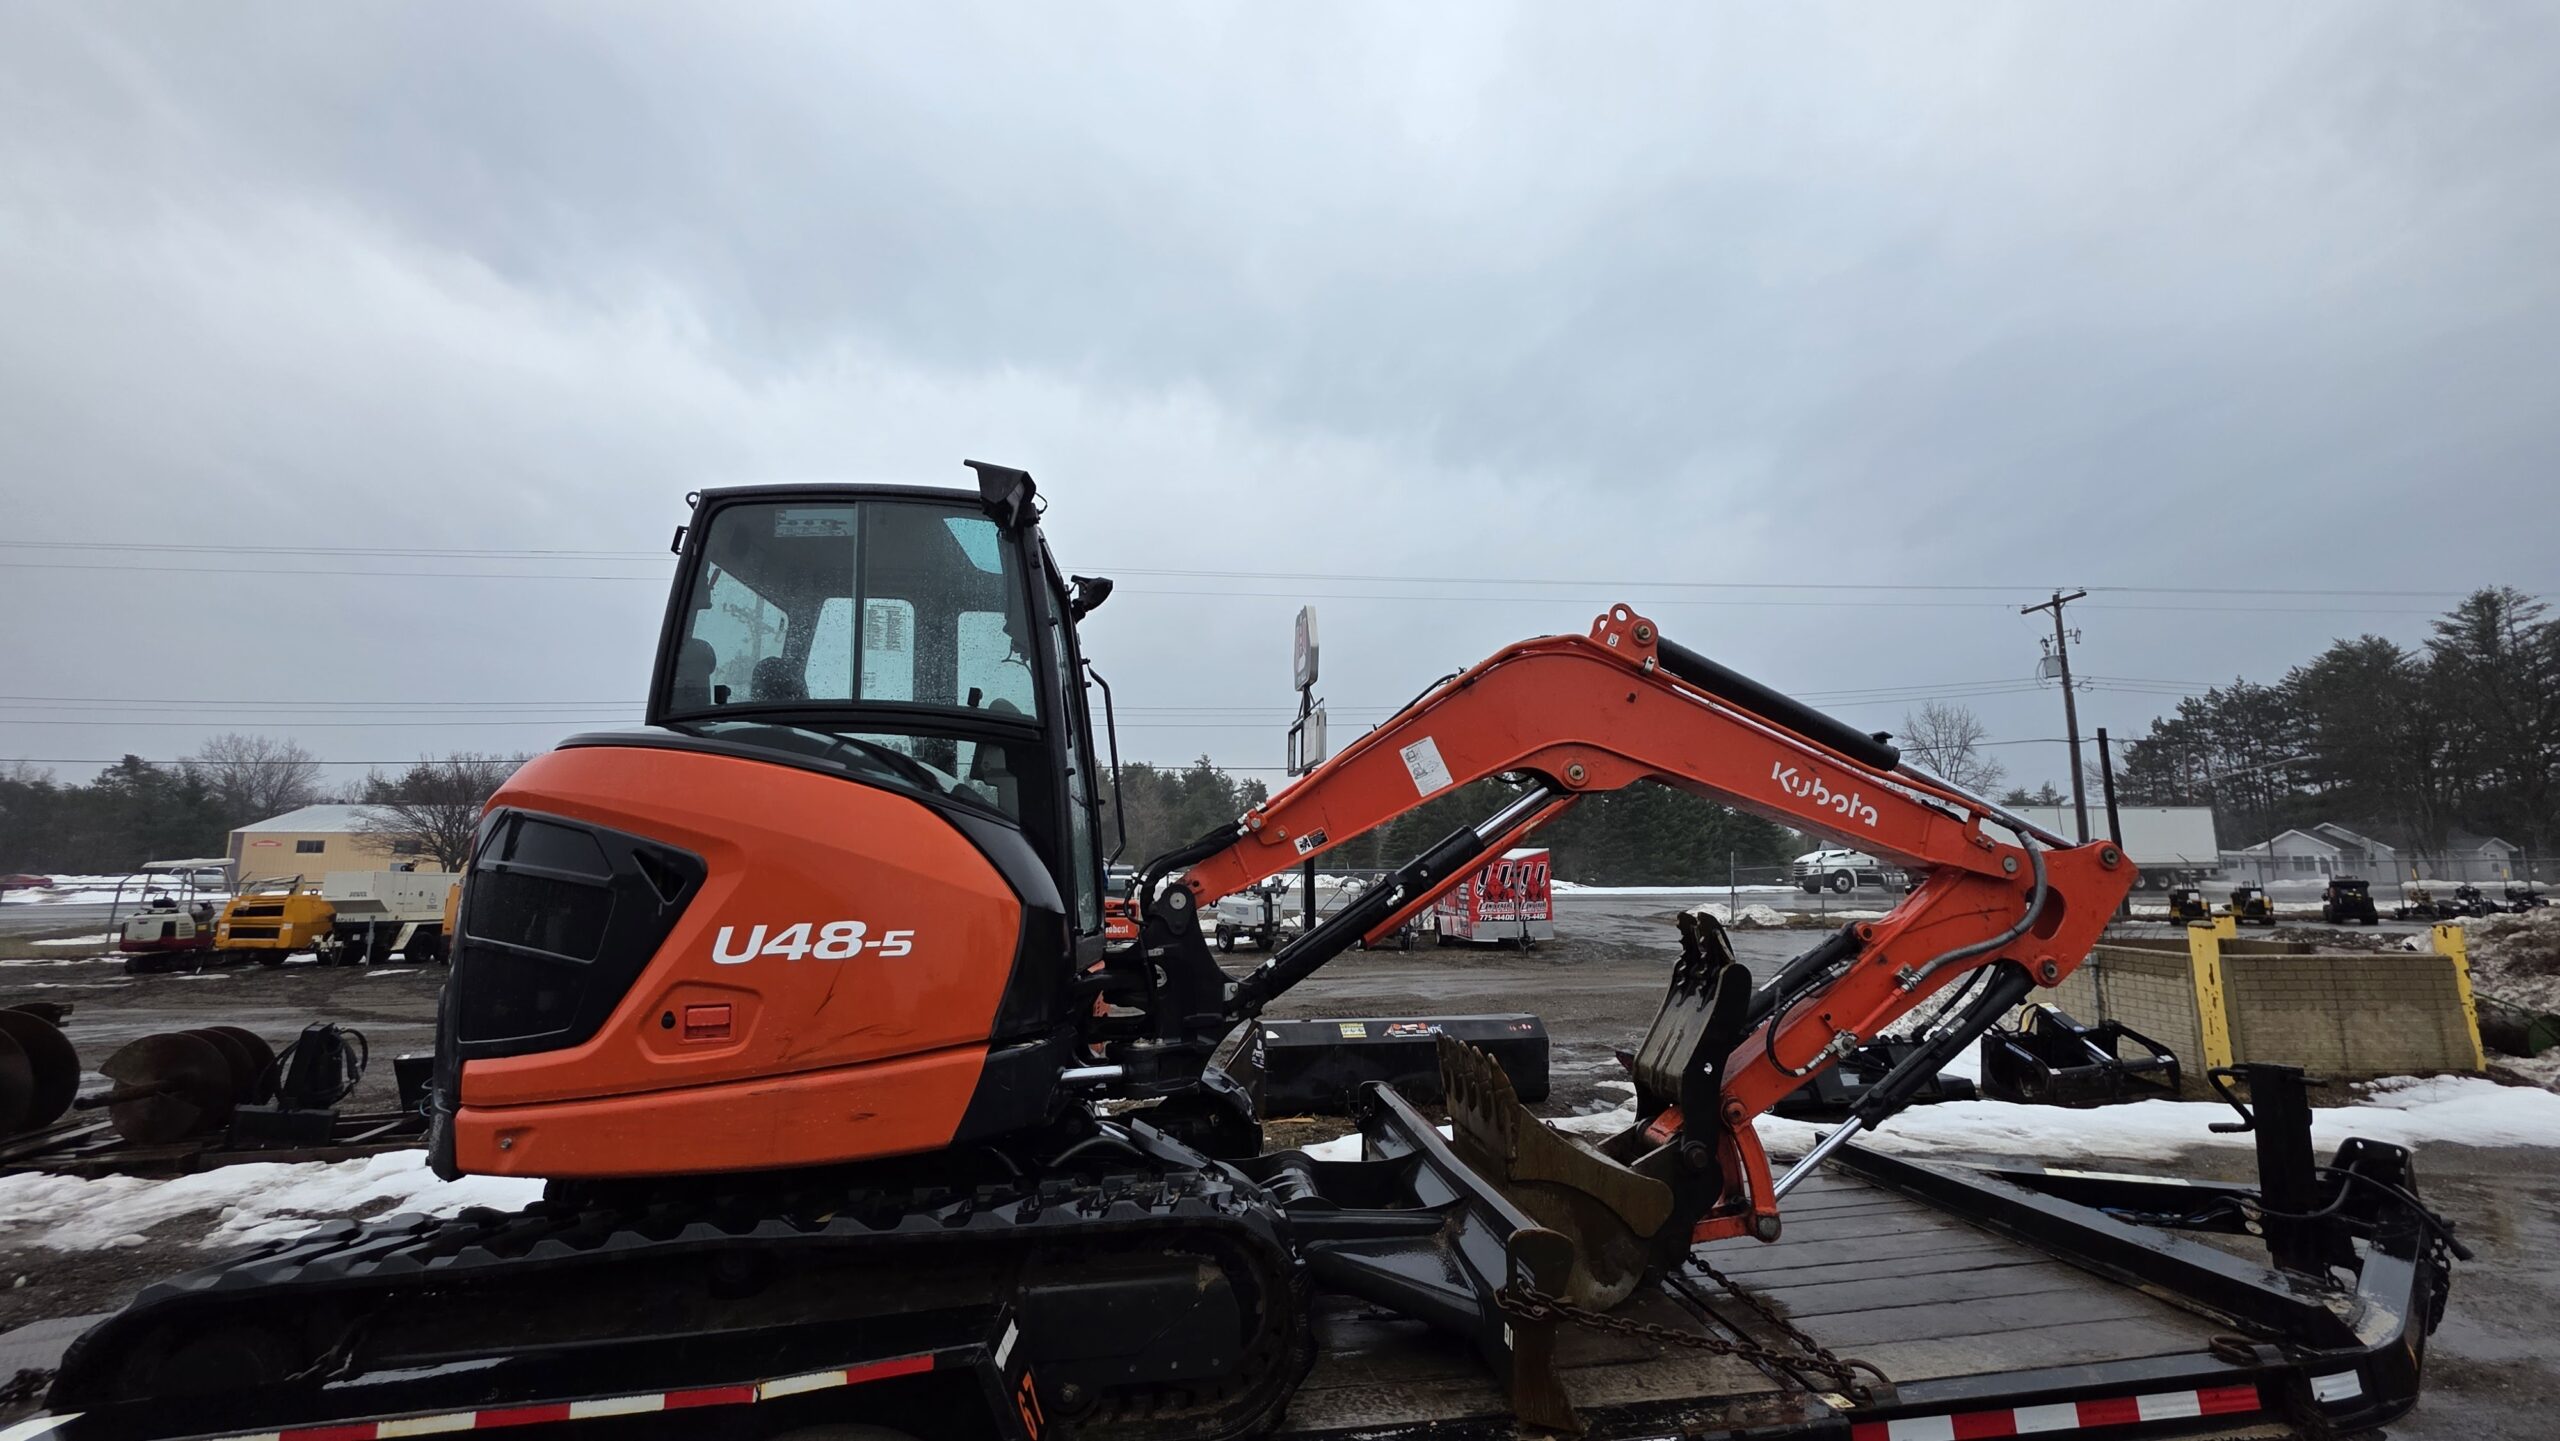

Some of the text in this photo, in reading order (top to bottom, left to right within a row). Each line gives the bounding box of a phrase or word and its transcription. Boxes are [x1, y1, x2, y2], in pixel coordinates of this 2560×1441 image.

[1771, 761, 1878, 827] Kubota
[712, 920, 915, 964] U48-5
[1018, 1371, 1044, 1441] 67
